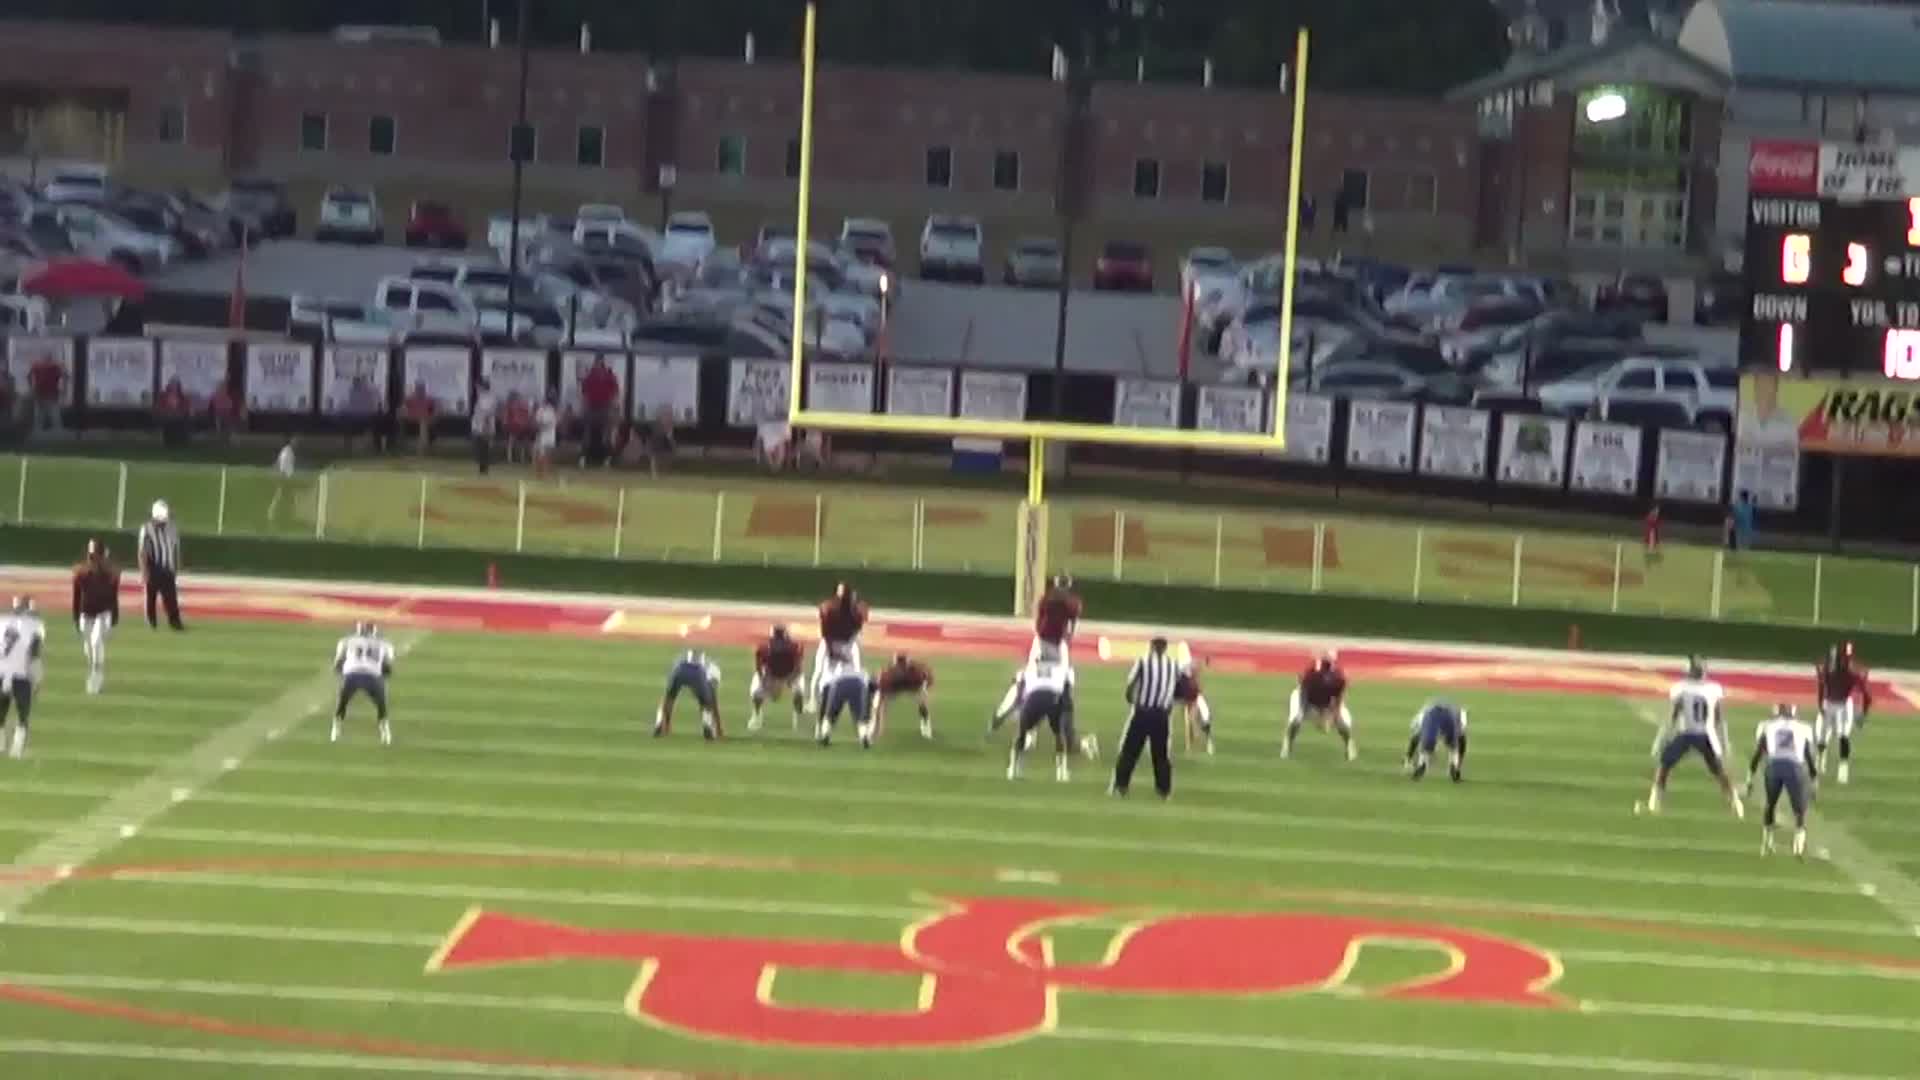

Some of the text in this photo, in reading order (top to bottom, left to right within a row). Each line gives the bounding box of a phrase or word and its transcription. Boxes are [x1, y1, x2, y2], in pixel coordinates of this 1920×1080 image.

[1752, 199, 1821, 226] VISITOR
[1753, 294, 1808, 322] DOWN
[1779, 322, 1793, 373] 1
